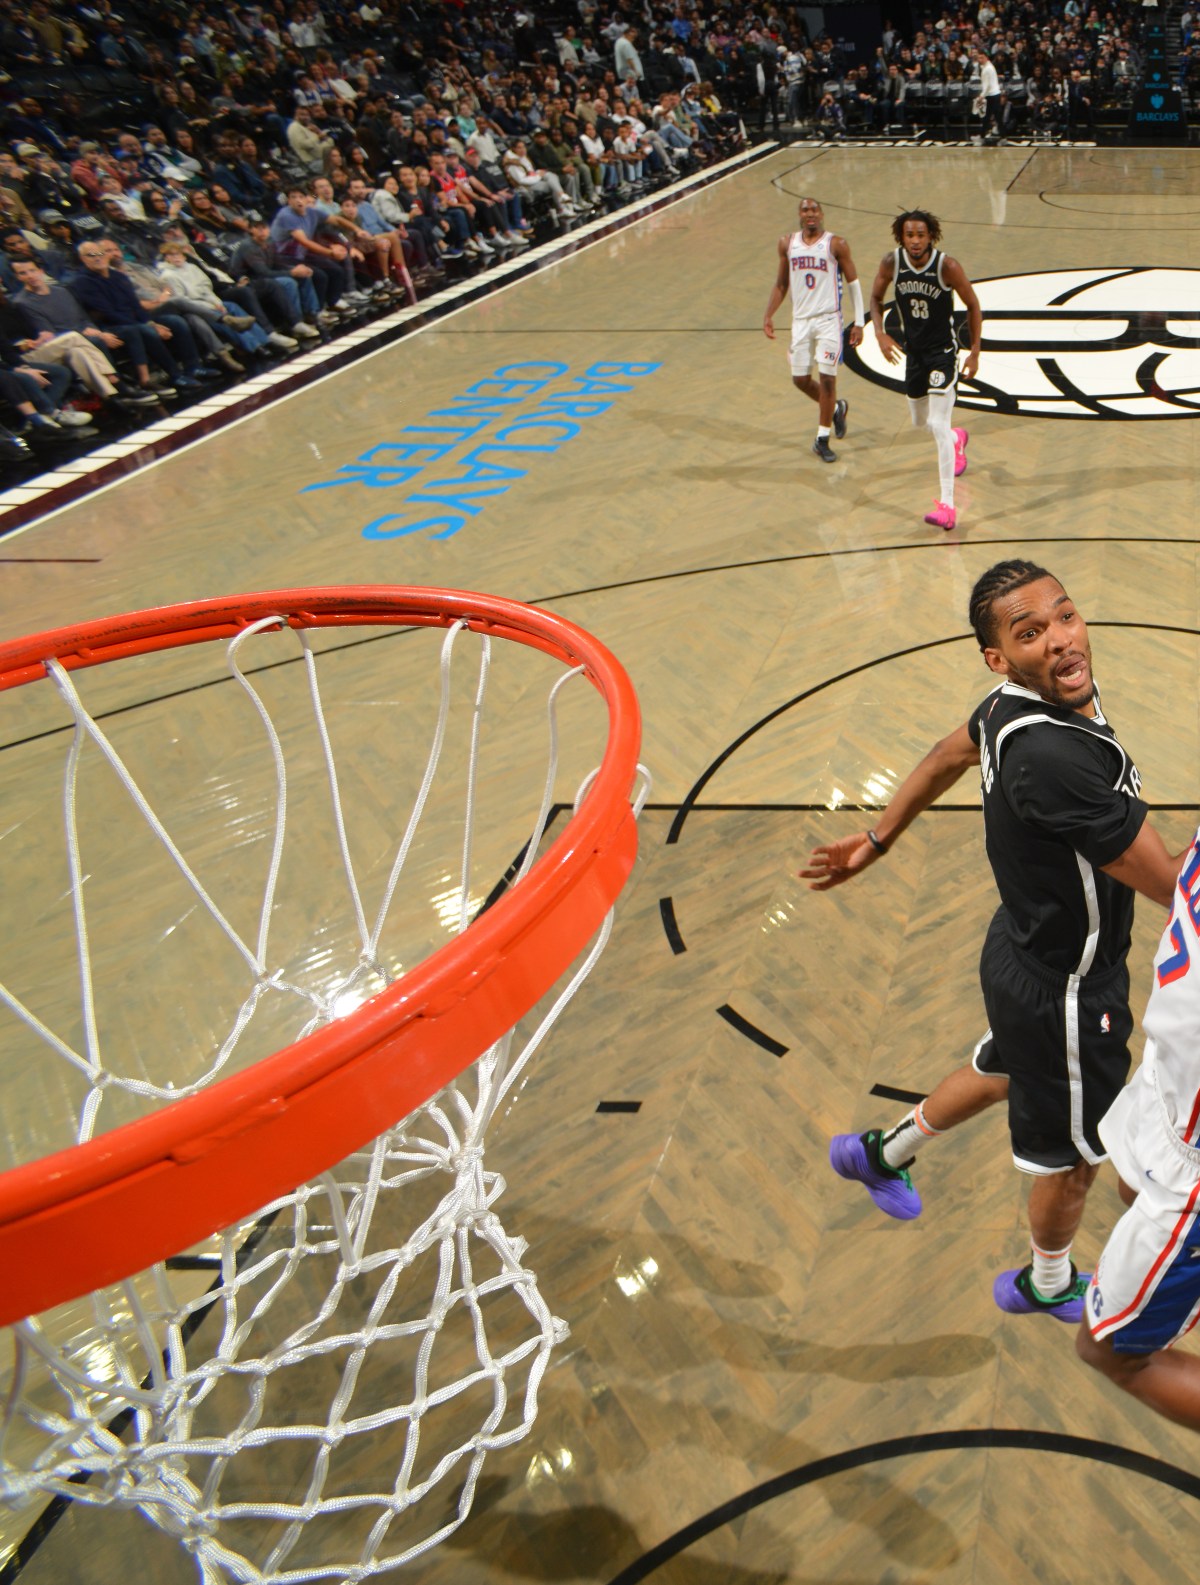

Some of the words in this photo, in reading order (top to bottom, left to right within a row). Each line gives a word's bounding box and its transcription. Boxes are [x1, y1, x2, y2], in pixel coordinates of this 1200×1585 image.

[1136, 112, 1179, 121] BARCLAYS
[791, 255, 829, 272] PHILA
[805, 273, 816, 290] 0
[897, 280, 942, 300] BROOKLYN
[910, 298, 930, 319] 33
[823, 352, 836, 361] 76
[298, 361, 570, 494] CENTER
[360, 361, 664, 540] BARCLAYS
